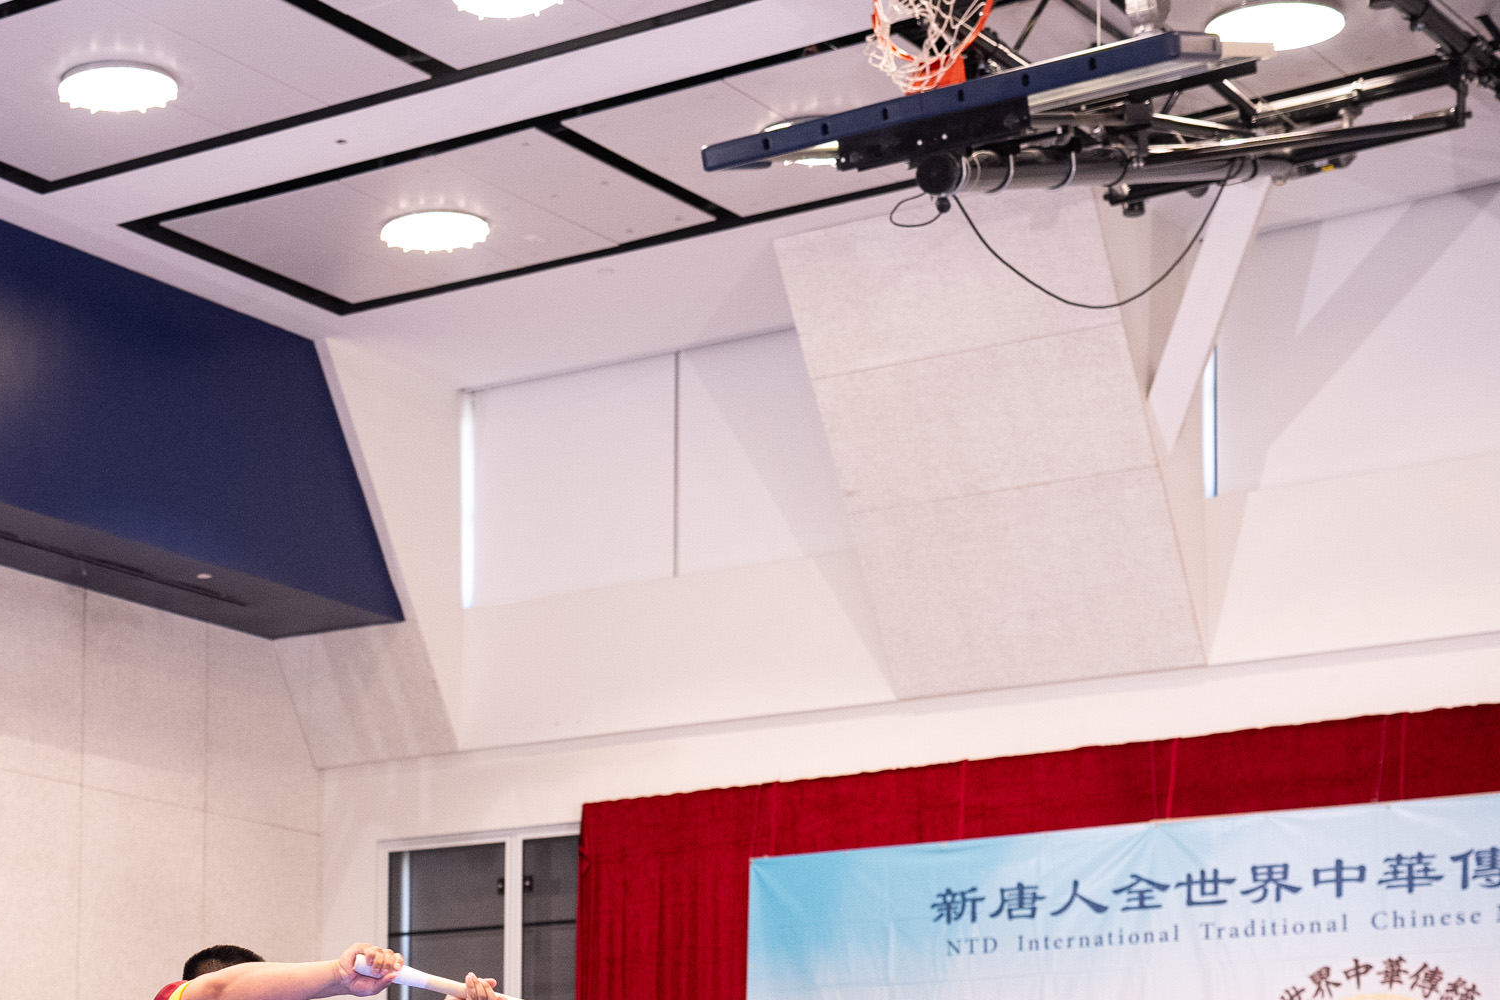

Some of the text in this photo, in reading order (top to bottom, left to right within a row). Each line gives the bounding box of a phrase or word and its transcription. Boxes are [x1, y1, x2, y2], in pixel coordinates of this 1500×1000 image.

[929, 845, 1500, 925] 新唐人全世界中華傳
[947, 936, 998, 957] NTD
[1017, 924, 1180, 953] International
[1199, 913, 1348, 940] Traditional
[1371, 908, 1482, 931] Chinese
